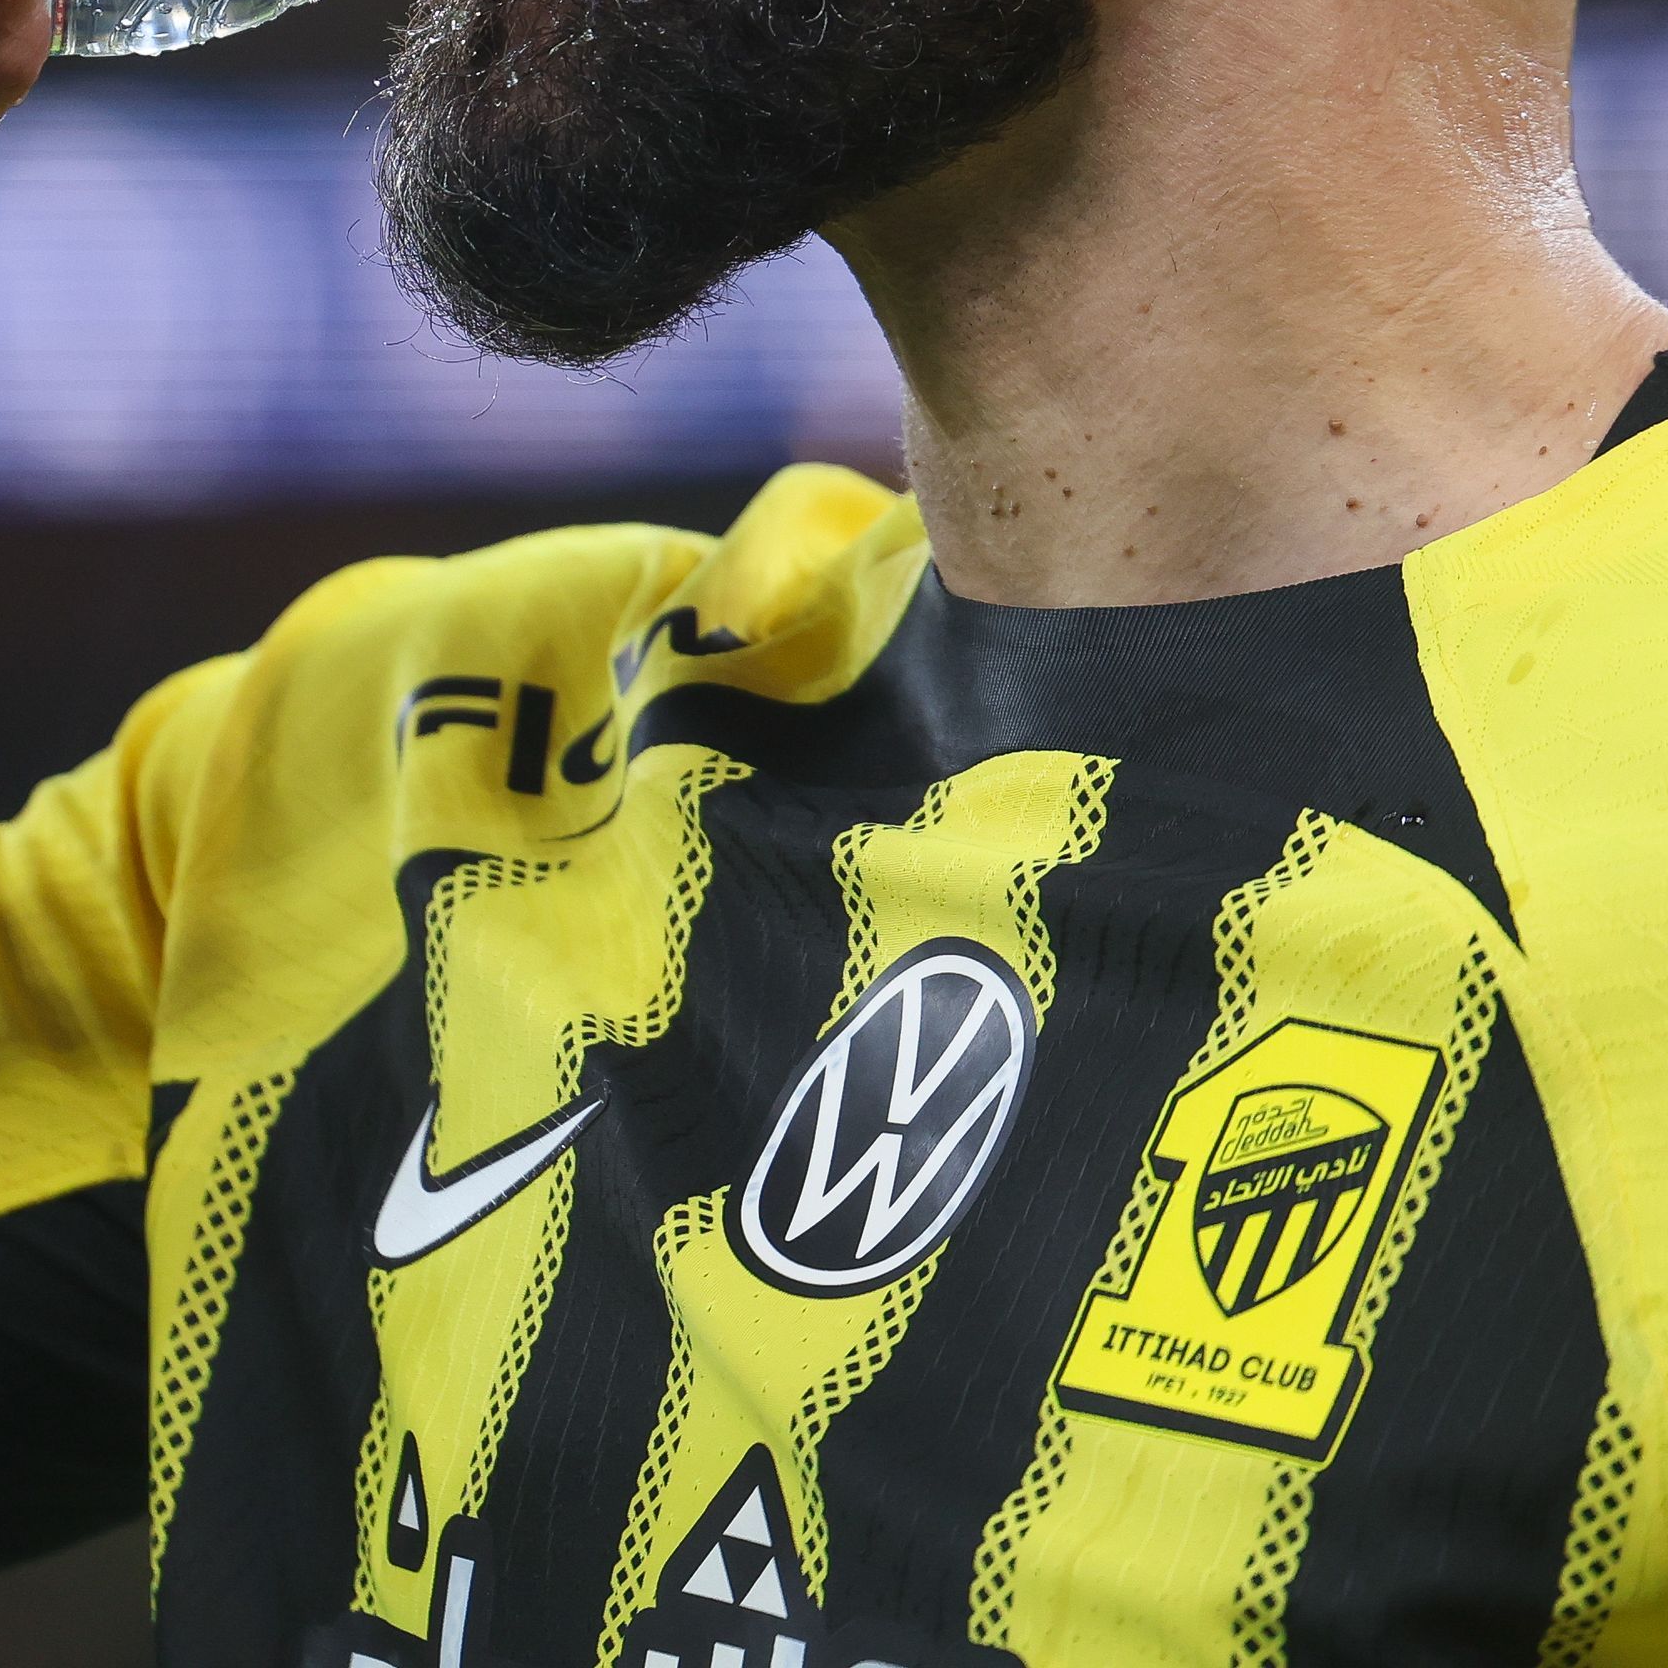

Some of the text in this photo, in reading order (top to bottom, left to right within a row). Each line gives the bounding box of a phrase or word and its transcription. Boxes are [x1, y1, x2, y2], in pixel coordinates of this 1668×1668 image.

[1202, 1143, 1373, 1213] نادي الاتحاد
[1102, 1323, 1318, 1393] ITTIHAD CLUB
[1207, 1385, 1249, 1407] 1927
